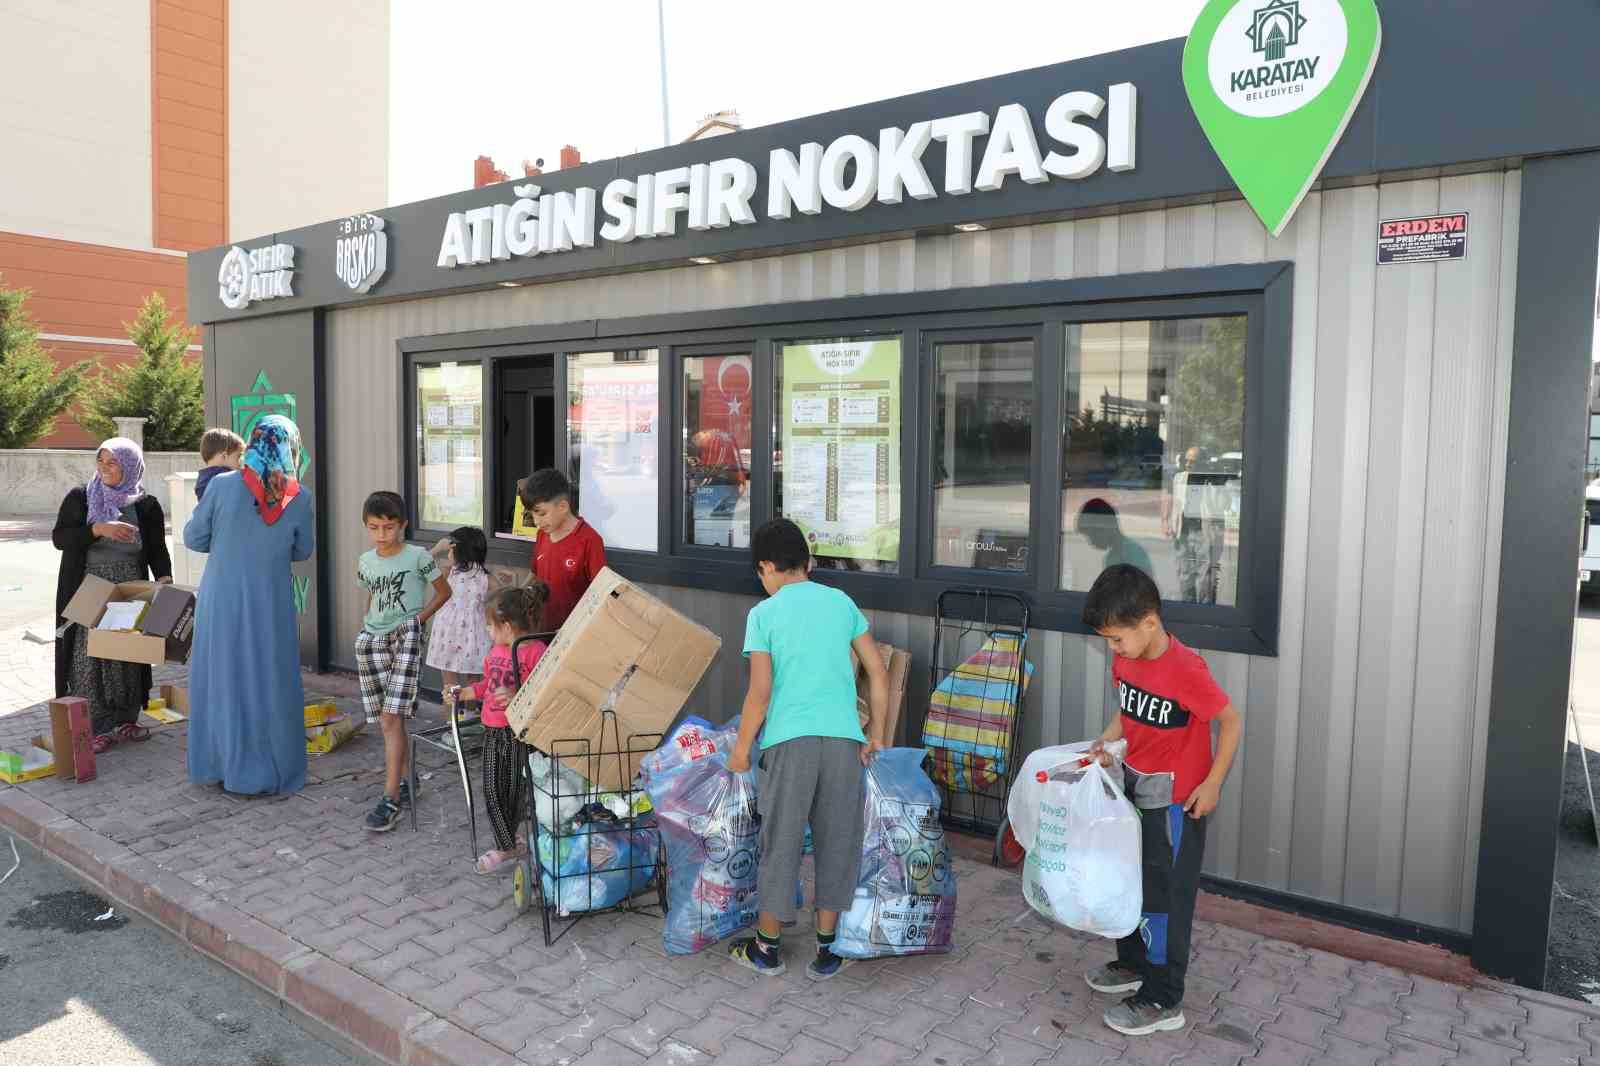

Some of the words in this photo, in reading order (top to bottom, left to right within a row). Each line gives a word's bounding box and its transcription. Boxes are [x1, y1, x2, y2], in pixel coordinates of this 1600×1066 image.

[1231, 56, 1320, 92] KARATAY
[437, 182, 596, 268] ATIĞIN
[600, 156, 757, 243] SIFIR
[768, 82, 1137, 220] NOKTASI
[1381, 215, 1464, 237] ERDEM
[249, 243, 295, 273] SIFIR
[248, 269, 294, 300] ATIK
[1119, 680, 1172, 725] REVER
